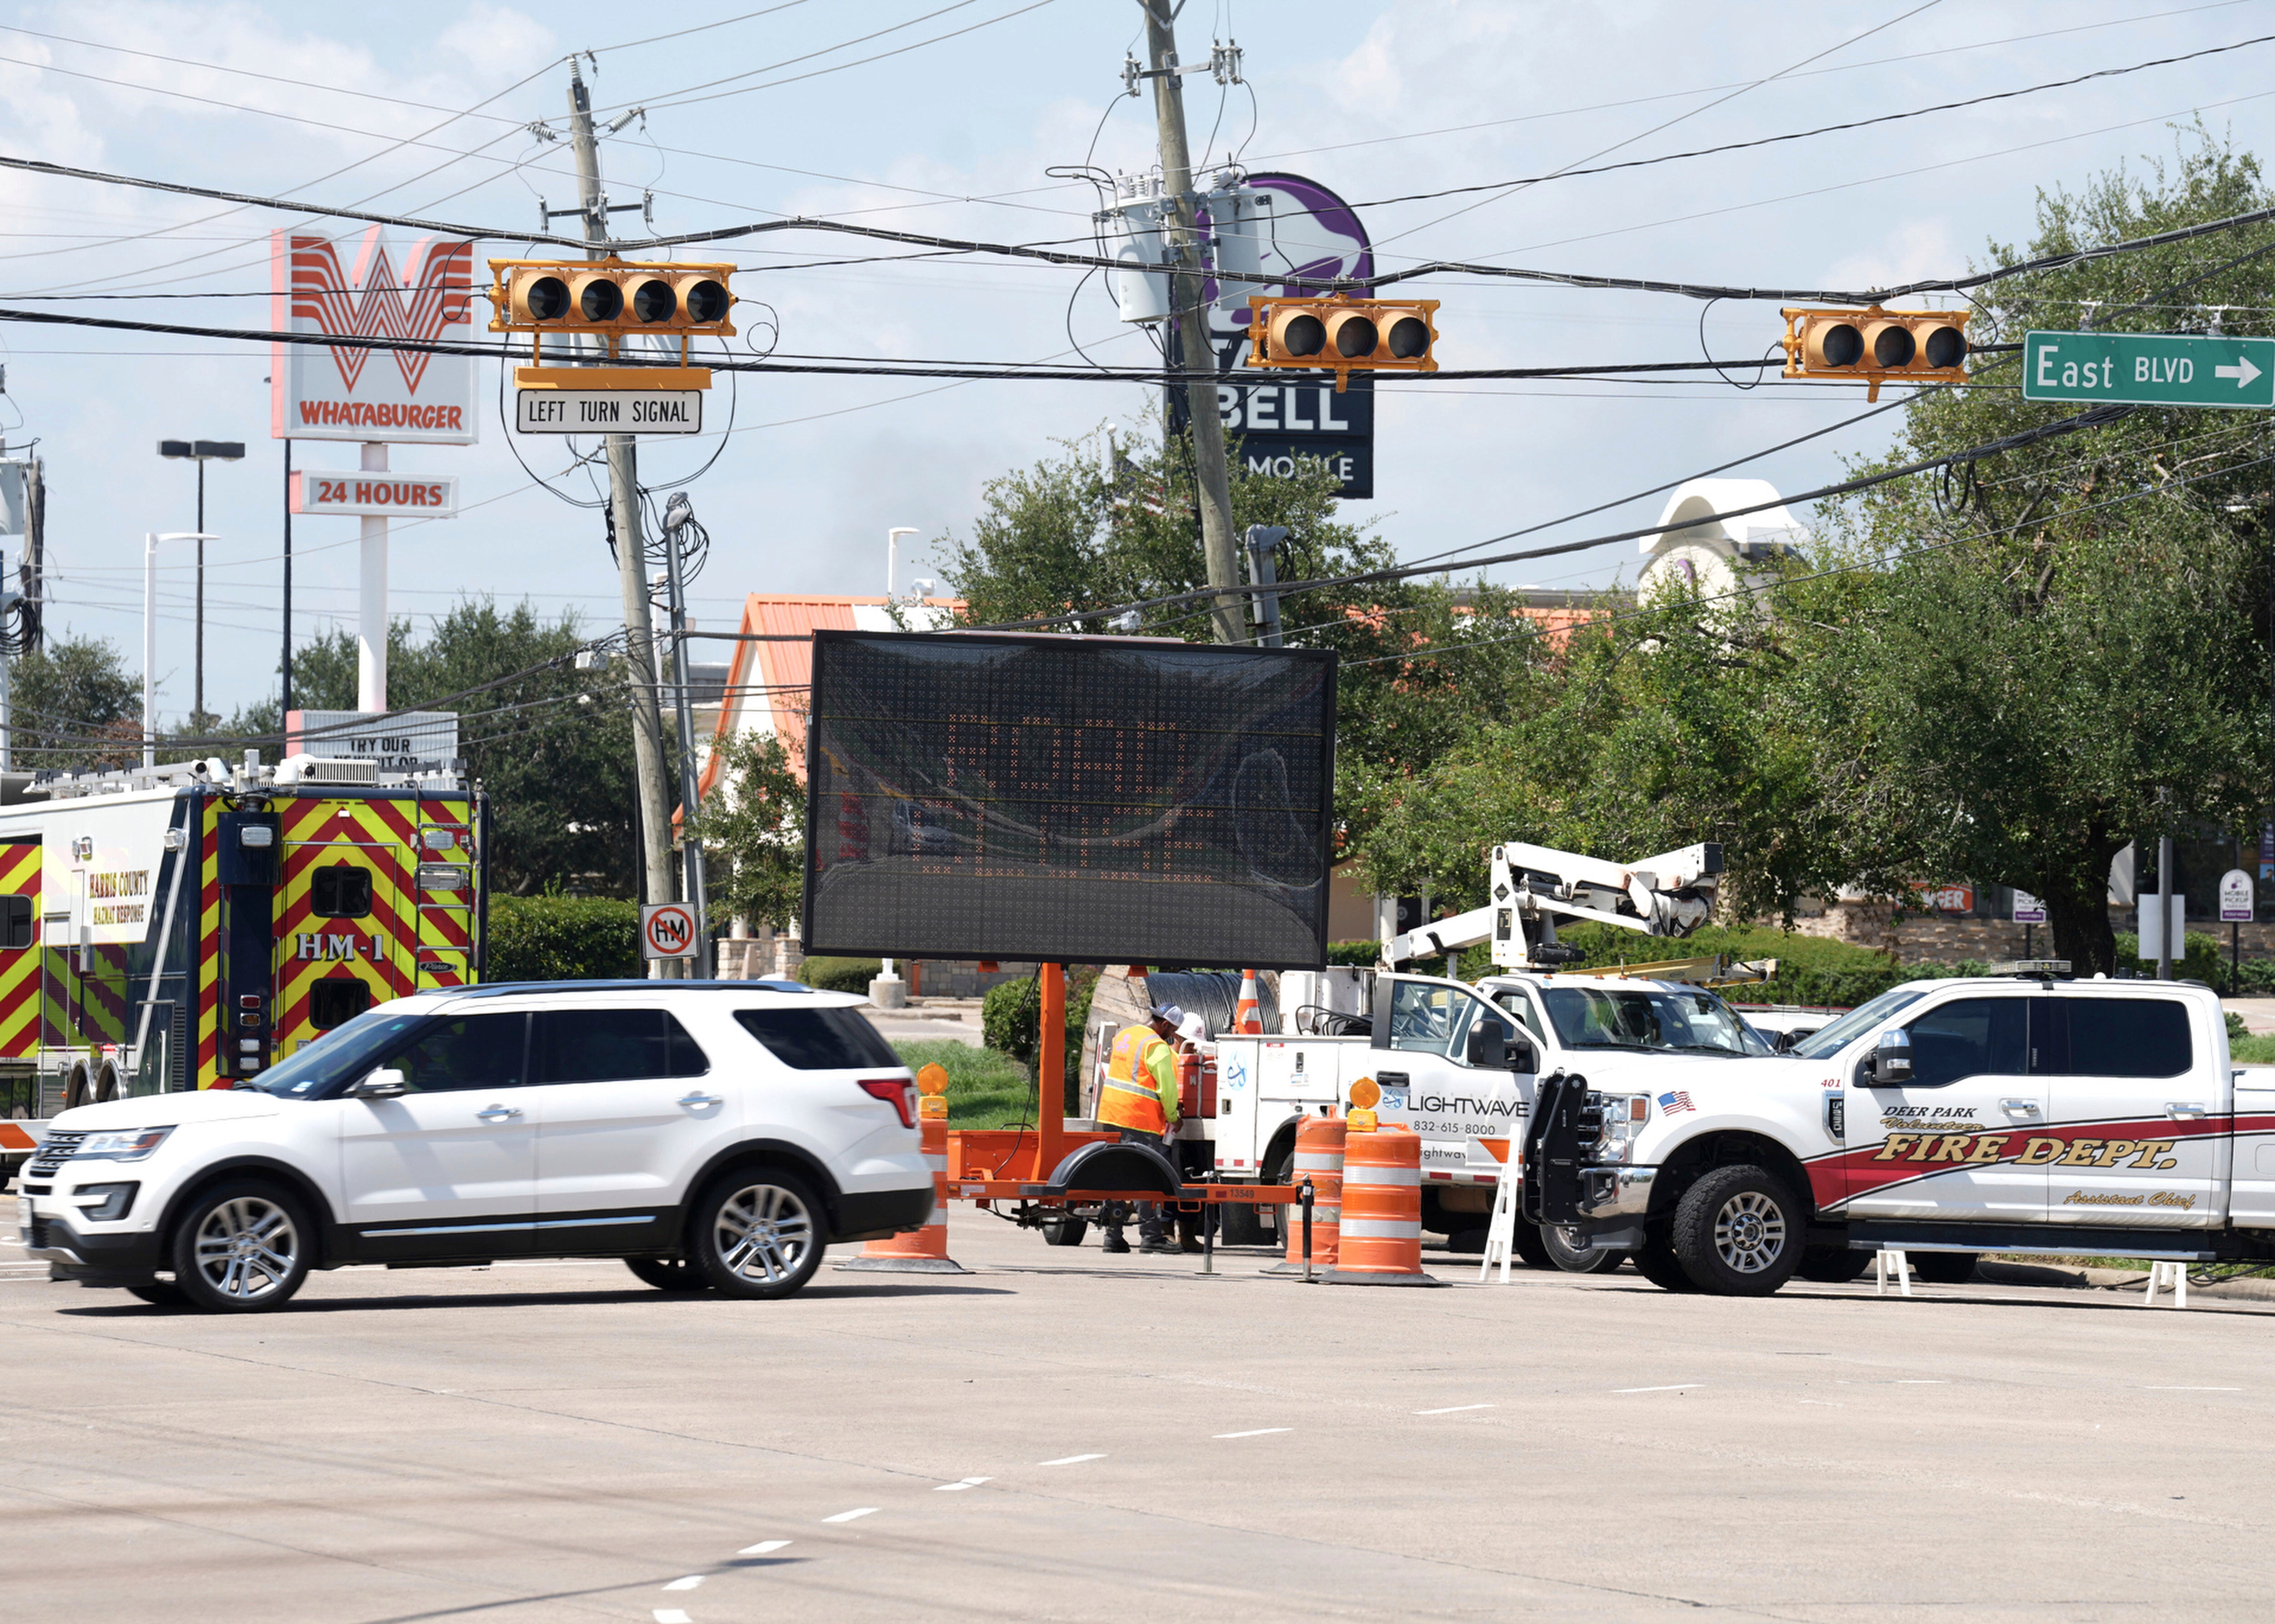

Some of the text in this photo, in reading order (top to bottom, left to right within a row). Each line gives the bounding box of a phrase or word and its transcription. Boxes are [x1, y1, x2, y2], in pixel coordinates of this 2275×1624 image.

[2037, 345, 2194, 388] East BLVD
[299, 400, 462, 430] WHATABURGER
[529, 401, 689, 422] LEFT TURN SIGNAL
[1216, 387, 1349, 430] BELL
[318, 481, 443, 506] 24 HOURS
[382, 738, 410, 753] OUR
[946, 714, 1186, 793] ROAD
[913, 802, 1213, 882] CLOSE
[90, 869, 149, 898] HARRIS COUNTY
[655, 918, 685, 943] HM
[1821, 1079, 1840, 1087] 401
[1407, 1094, 1530, 1117] LIGHTWAVE
[1882, 1106, 1978, 1118] DEER PARK
[1414, 1120, 1495, 1135] 832-615-8000
[1880, 1117, 1985, 1131] Volunteer
[1872, 1133, 2178, 1170] FIRE DEPT.
[1230, 1188, 1254, 1199] 13549
[2063, 1190, 2196, 1210] Assistant Chief
